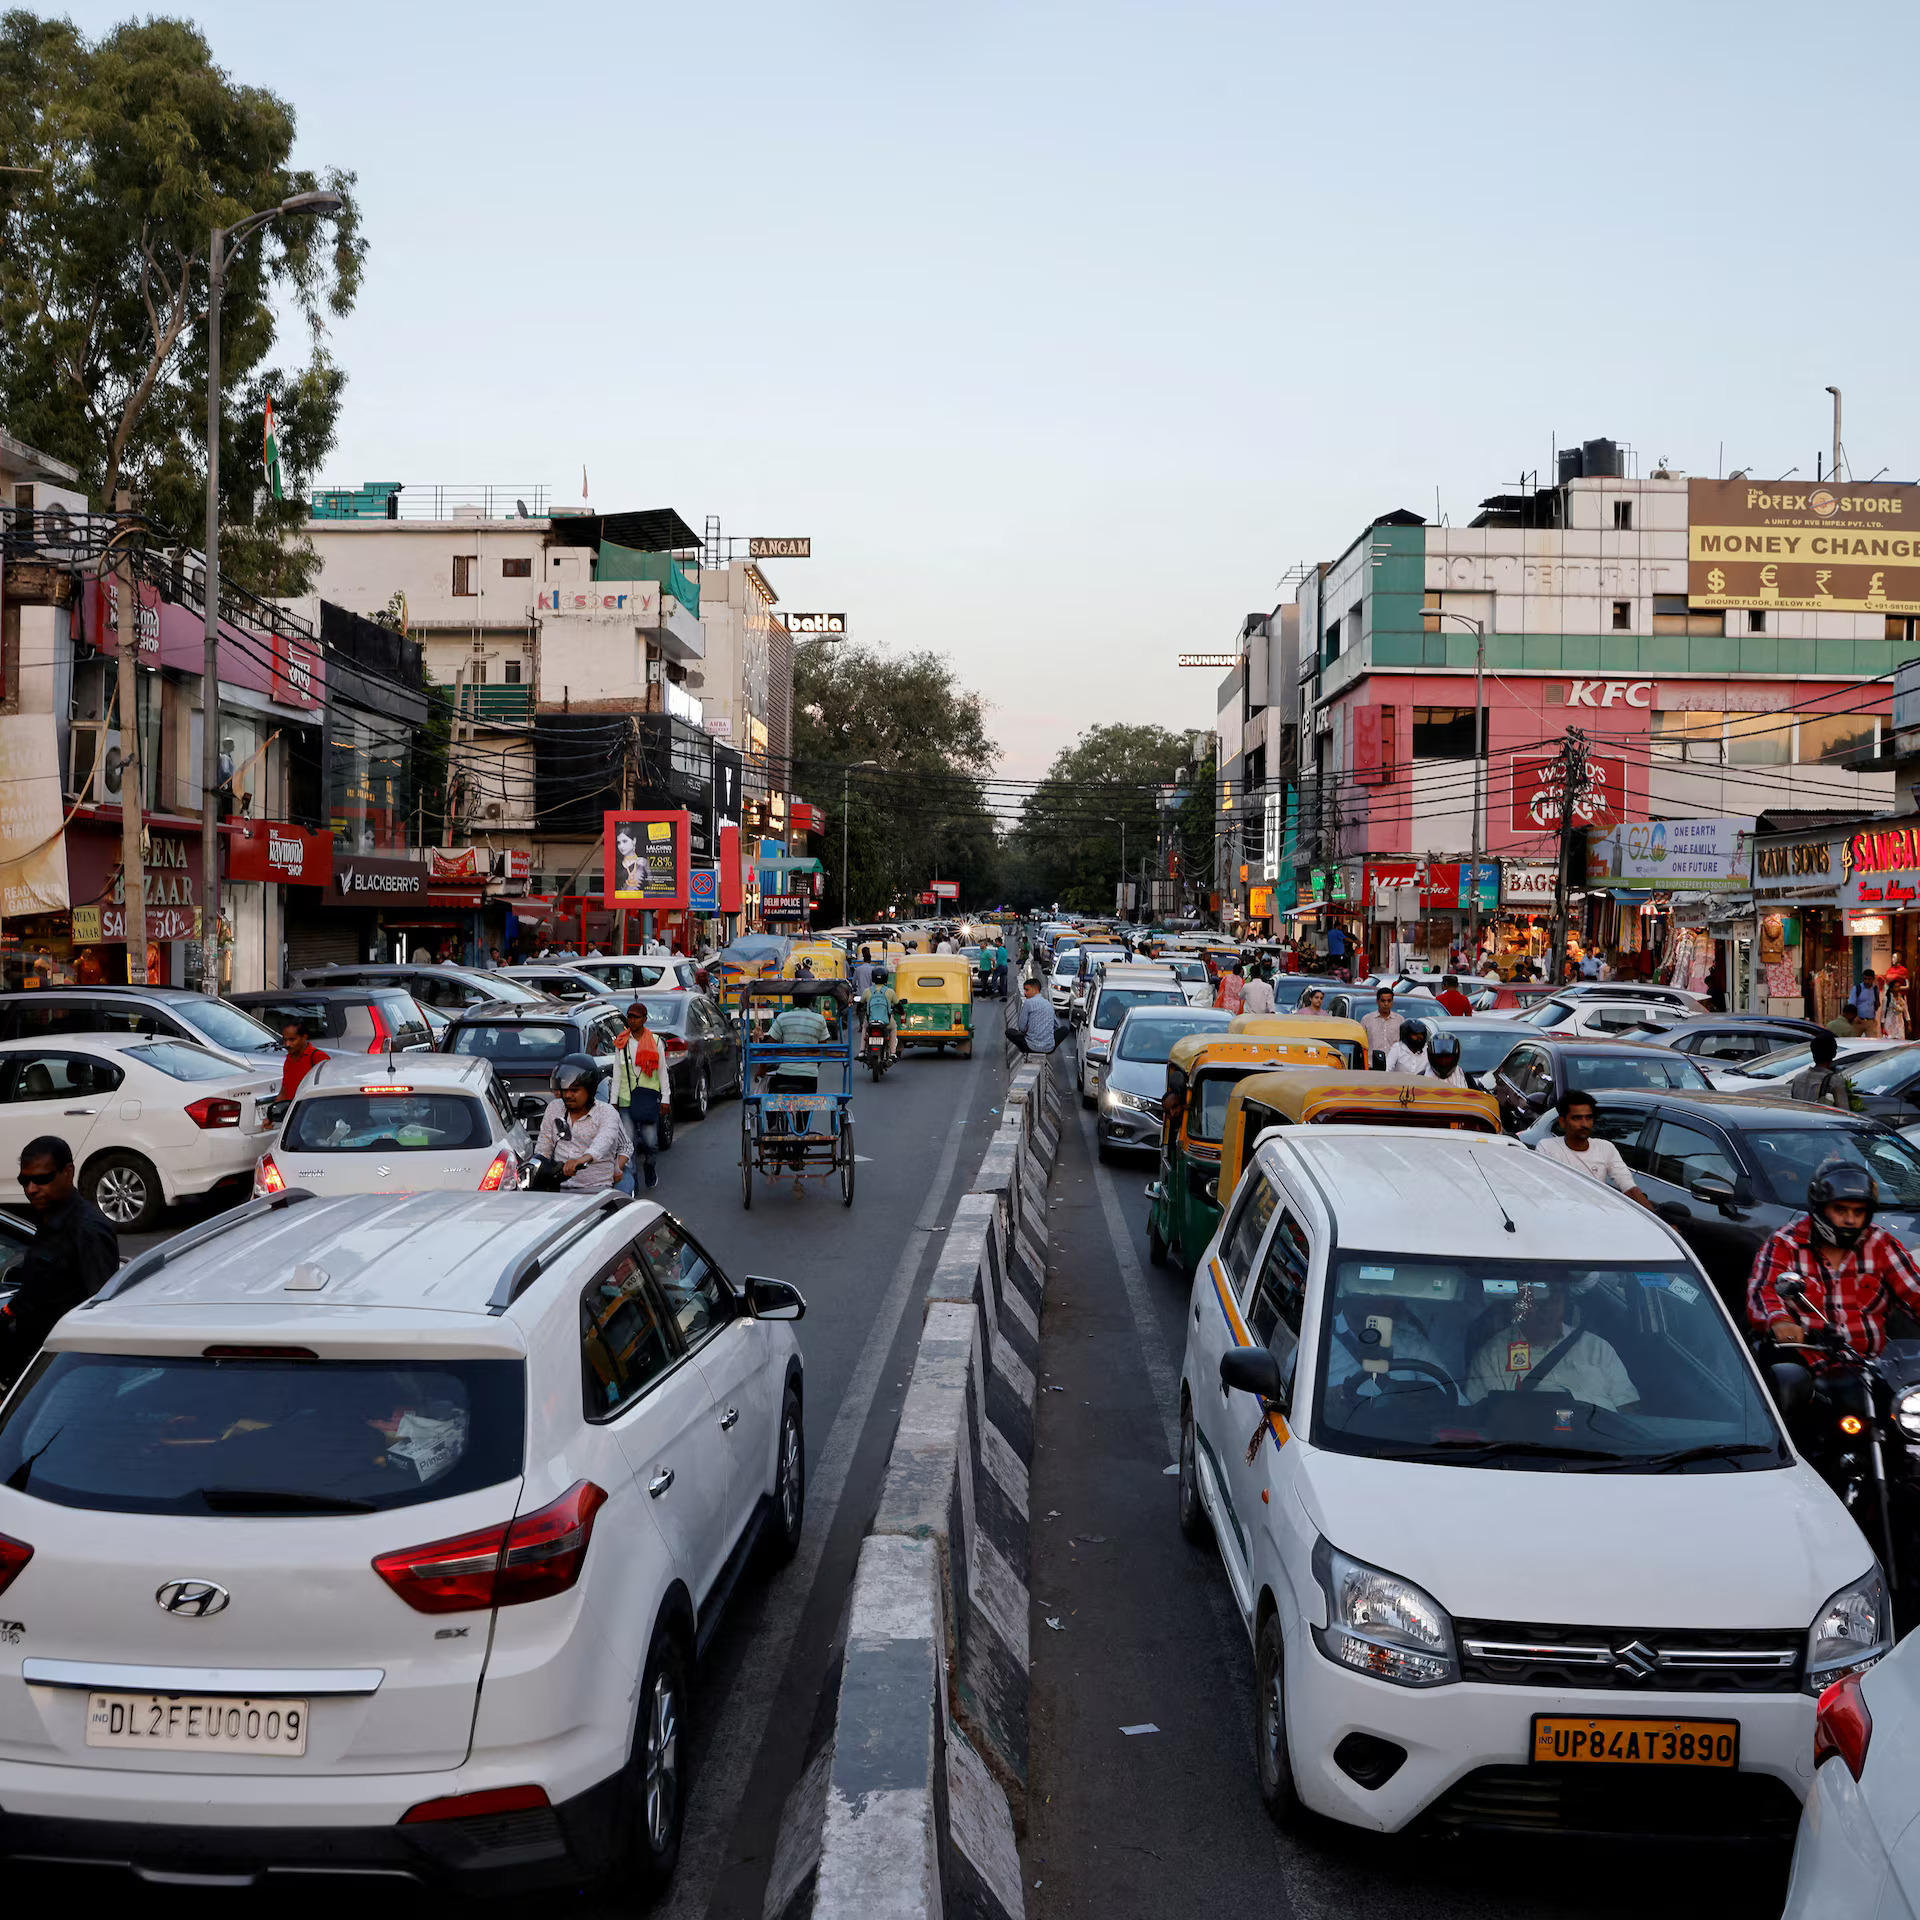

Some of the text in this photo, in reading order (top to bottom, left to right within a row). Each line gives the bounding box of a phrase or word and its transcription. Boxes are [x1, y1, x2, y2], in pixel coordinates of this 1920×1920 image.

[1747, 488, 1763, 496] The
[1840, 497, 1902, 514] STORE
[1764, 518, 1772, 526] A
[1772, 518, 1788, 526] UNIT
[1792, 518, 1804, 526] OF
[1821, 519, 1847, 528] IMPEX
[1847, 520, 1866, 529] PVT.
[1866, 521, 1885, 529] LTD.
[750, 540, 810, 555] SANGAM
[1700, 535, 1802, 554] MONEY
[538, 589, 652, 611] kidsberry
[1704, 598, 1822, 608] GROUND FLOOR, BELOW KFC
[787, 613, 843, 632] batla
[1565, 680, 1653, 708] KFC
[269, 829, 279, 839] THE
[1674, 825, 1716, 837] ONE EARTH
[1673, 843, 1717, 855] ONE FAMILY
[1792, 842, 1831, 876] SONS
[287, 864, 303, 876] SHOP
[1672, 862, 1687, 873] ONE
[1689, 861, 1718, 873] FUTURE
[354, 873, 420, 893] BLACKBERRYS
[1509, 873, 1560, 892] BAGS
[112, 875, 194, 906] BZAAR
[764, 897, 780, 906] DELHI
[780, 897, 801, 907] POLICE
[1673, 1285, 1694, 1295] CNG
[0, 1619, 26, 1632] TA
[109, 1702, 301, 1741] DL2FEU0009
[1539, 1736, 1553, 1745] IND
[1554, 1729, 1733, 1763] UP84AT3890
